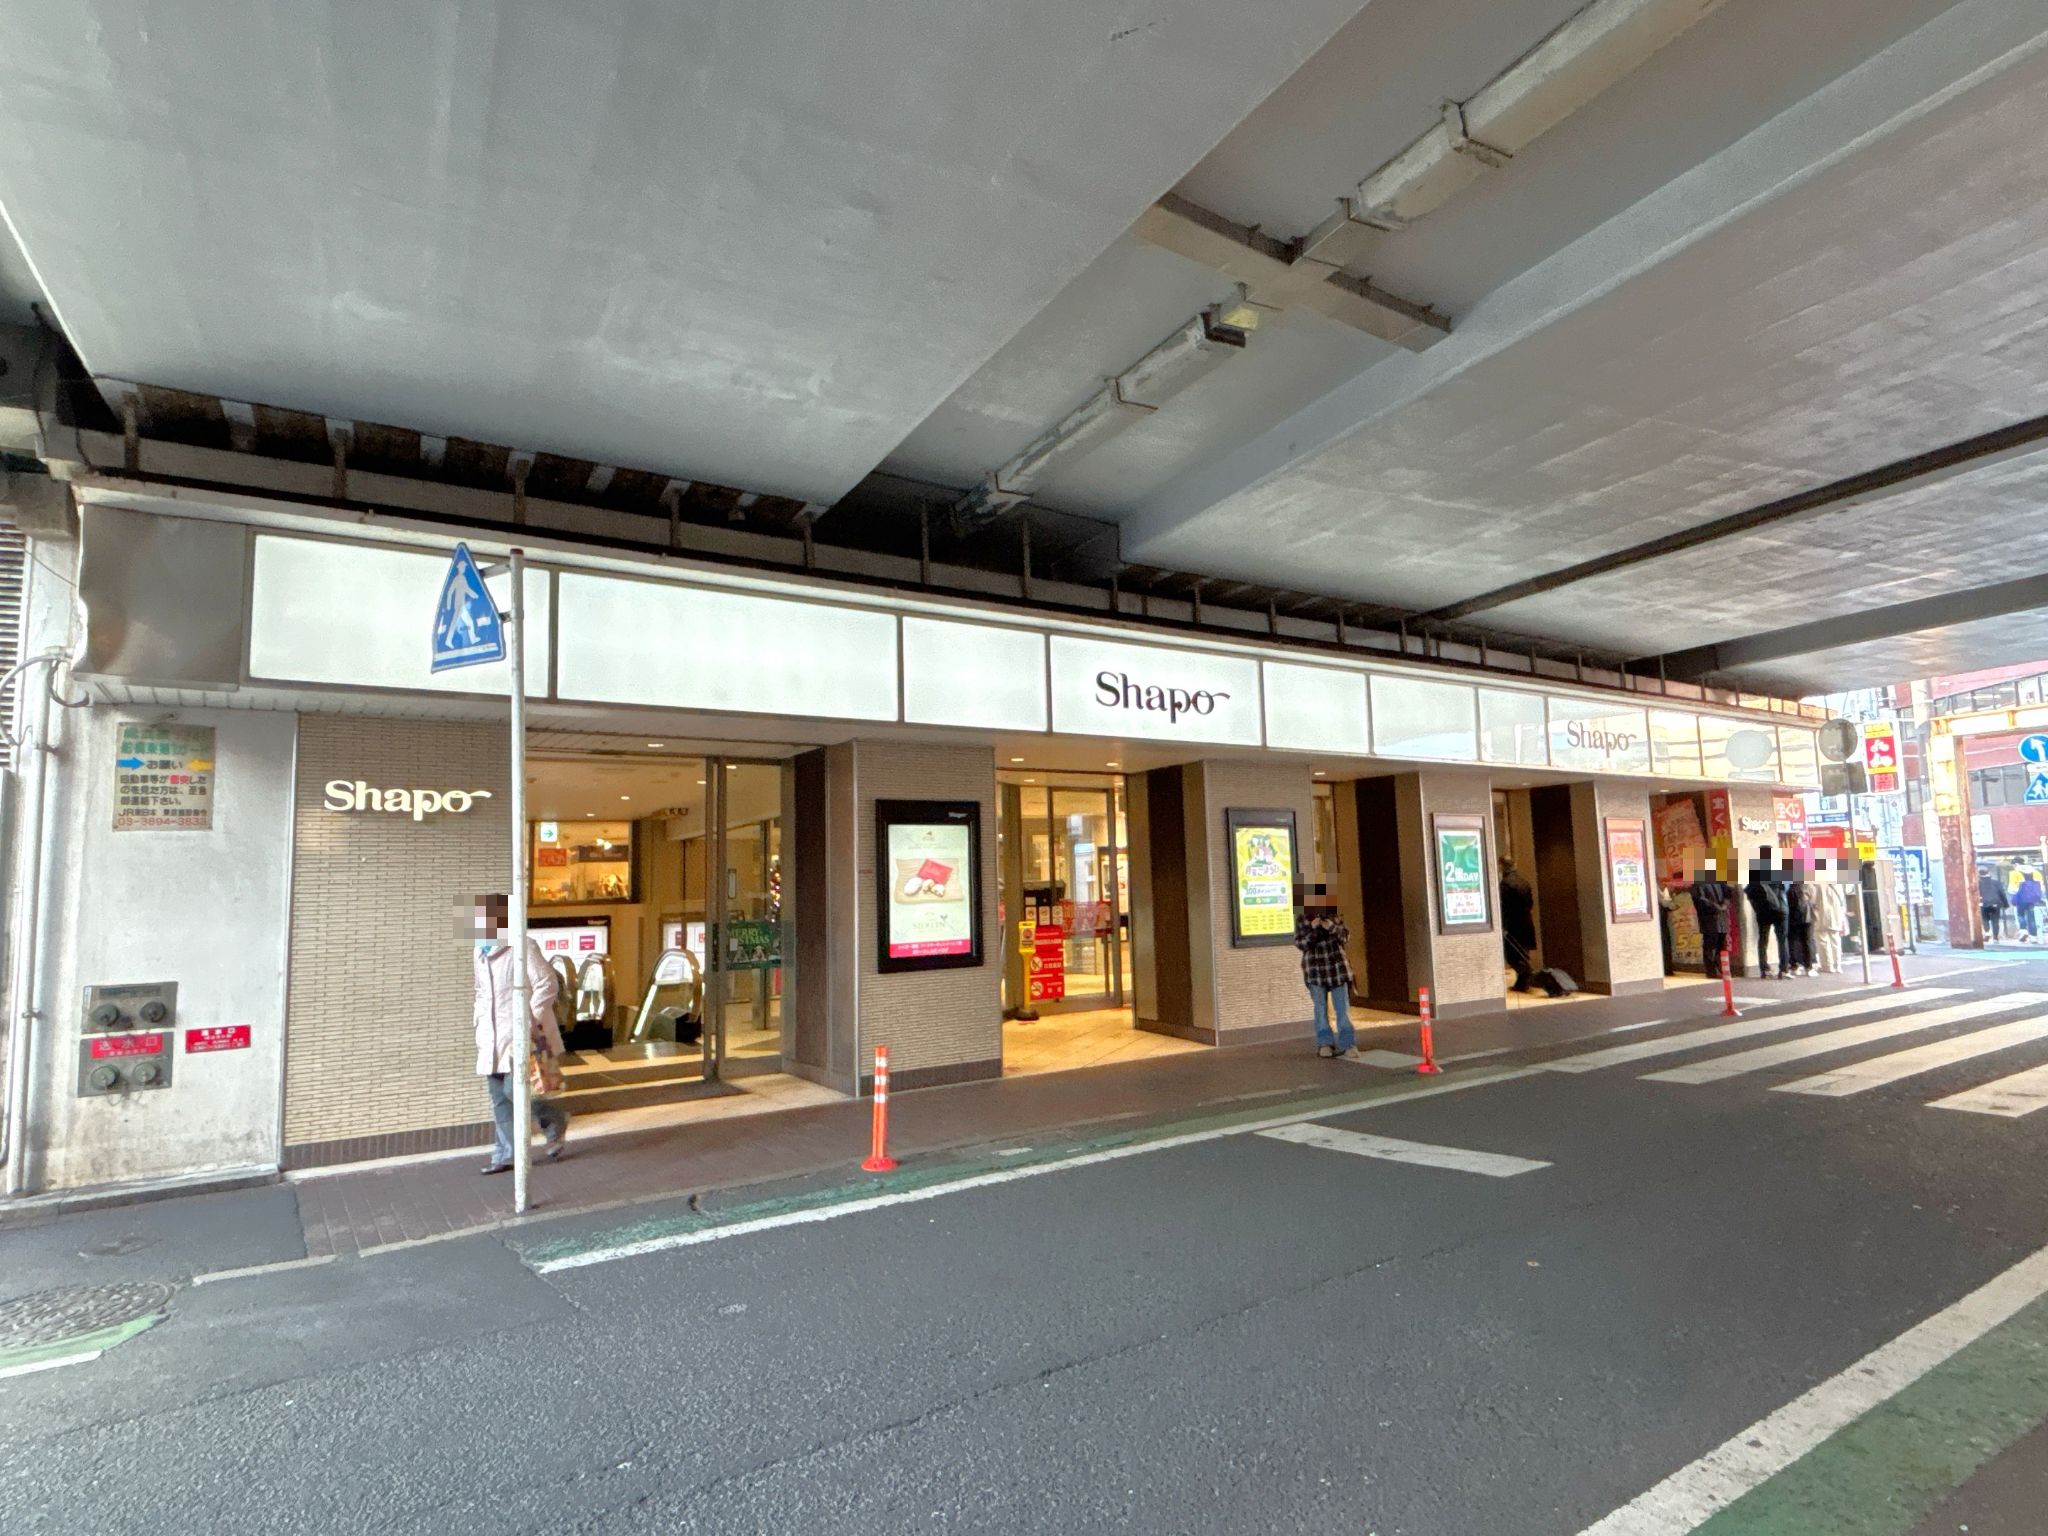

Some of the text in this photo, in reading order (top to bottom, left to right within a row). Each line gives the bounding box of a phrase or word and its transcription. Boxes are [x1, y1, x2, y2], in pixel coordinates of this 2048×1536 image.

[1096, 671, 1231, 724] Shapo
[1567, 720, 1637, 758] Shapo
[324, 780, 492, 821] Shapo
